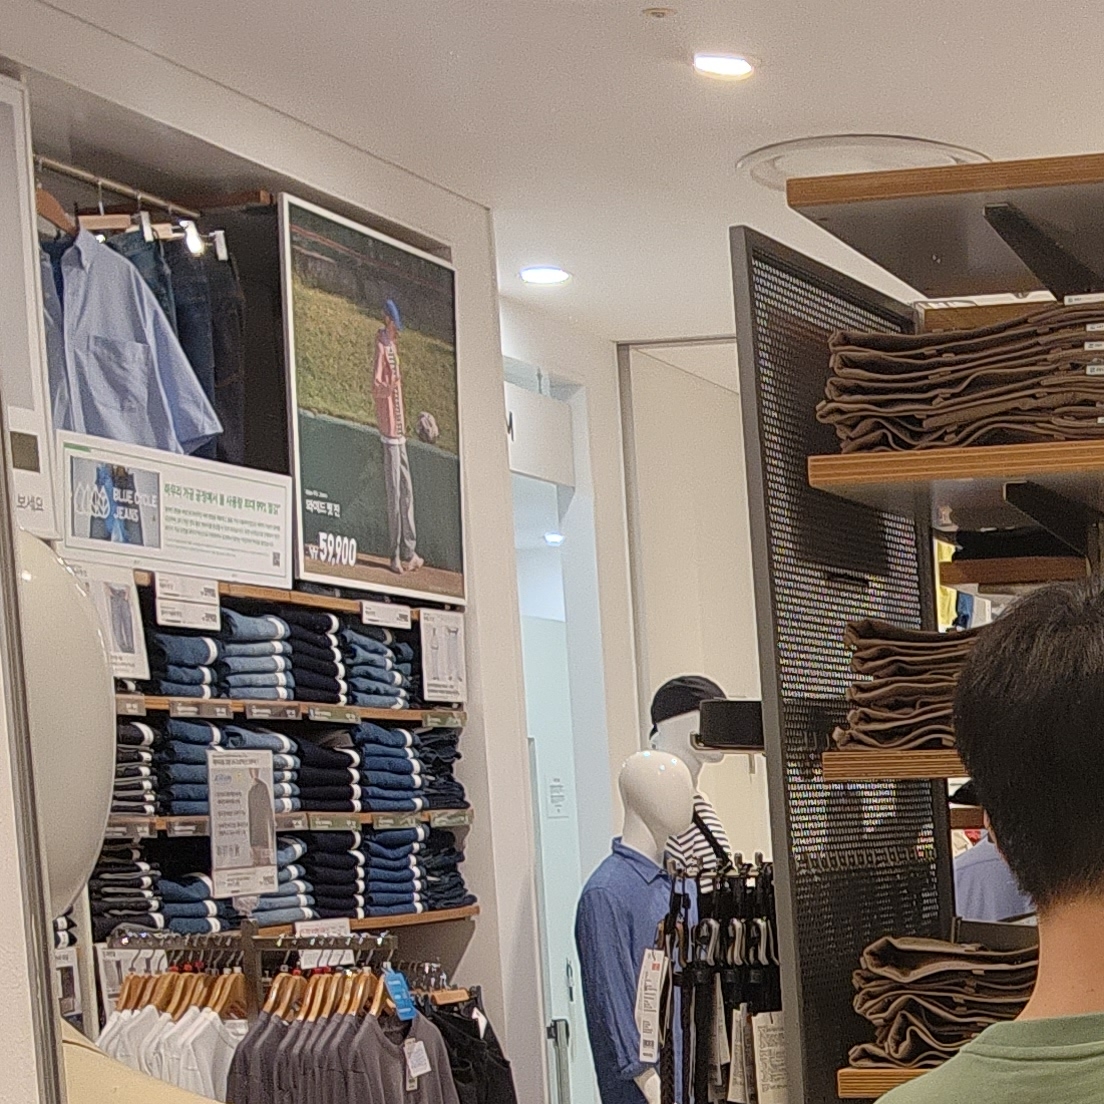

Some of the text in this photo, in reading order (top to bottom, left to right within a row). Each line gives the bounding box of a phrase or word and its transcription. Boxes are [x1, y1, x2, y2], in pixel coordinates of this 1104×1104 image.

[16, 494, 45, 512] 보세요
[113, 486, 134, 504] BLUE
[113, 506, 139, 522] JEANS
